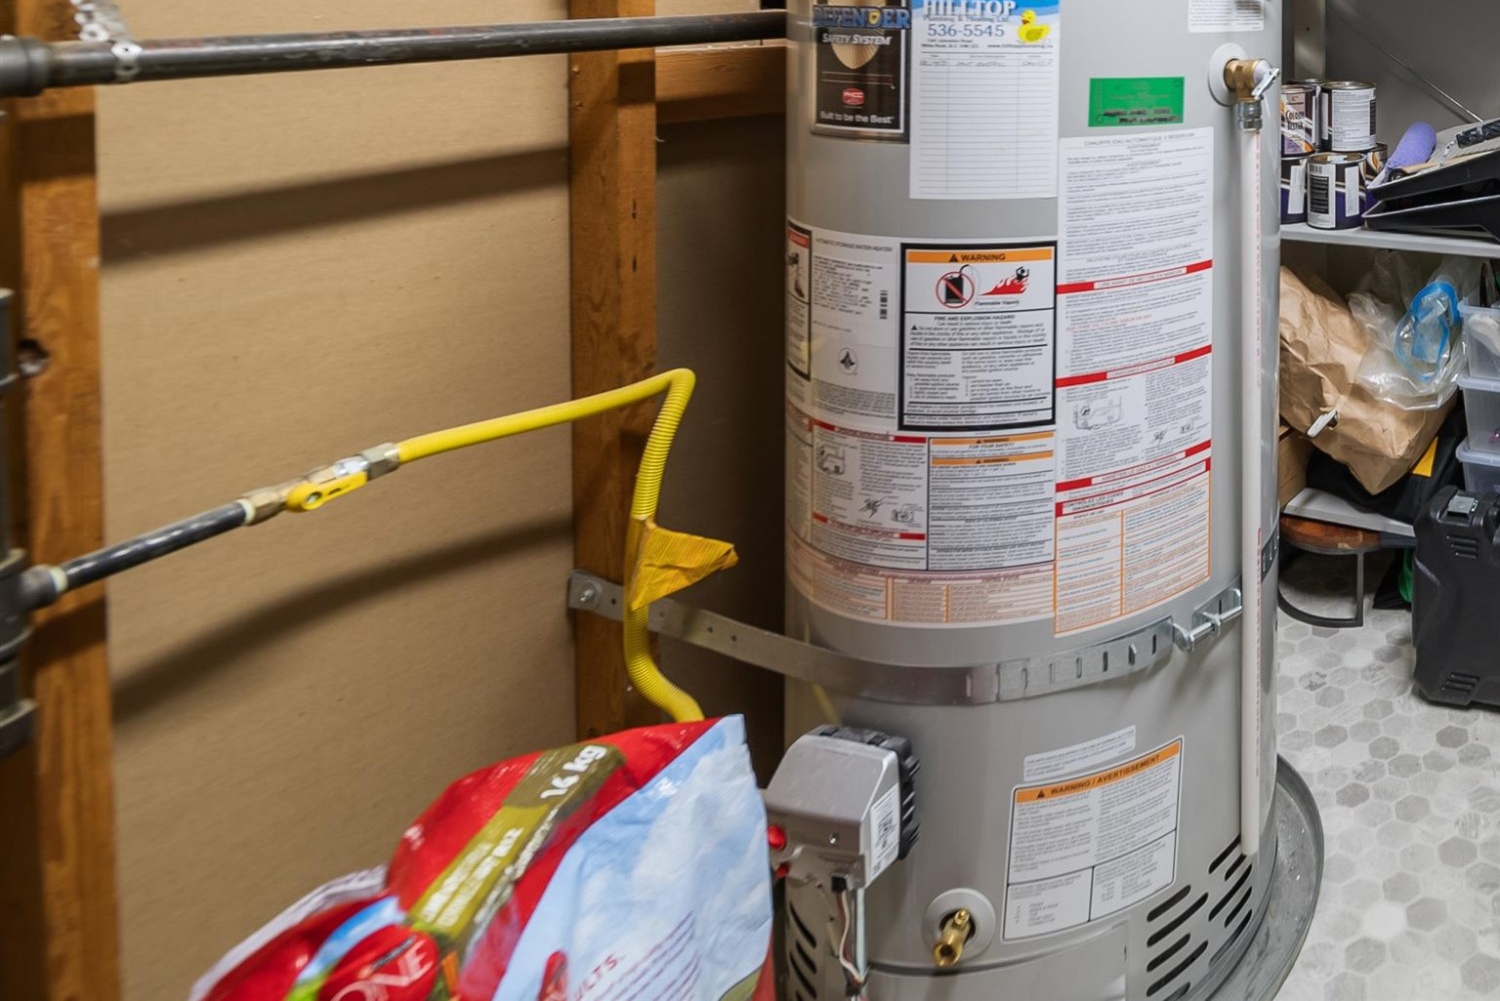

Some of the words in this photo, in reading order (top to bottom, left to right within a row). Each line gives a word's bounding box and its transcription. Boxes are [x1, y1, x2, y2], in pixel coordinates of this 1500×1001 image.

[923, 0, 1017, 17] HILLTOP
[813, 4, 911, 30] DEFENDER
[927, 23, 1005, 37] 536-5545
[822, 33, 851, 44] SAFETY
[834, 112, 842, 120] to
[843, 112, 854, 122] be
[855, 113, 869, 122] the
[870, 114, 892, 124] Best
[961, 254, 1006, 262] WARNING
[540, 772, 579, 800] 16
[562, 743, 608, 780] kg
[1050, 779, 1090, 795] WARNING
[1097, 754, 1160, 785] AVERTISSEMENT
